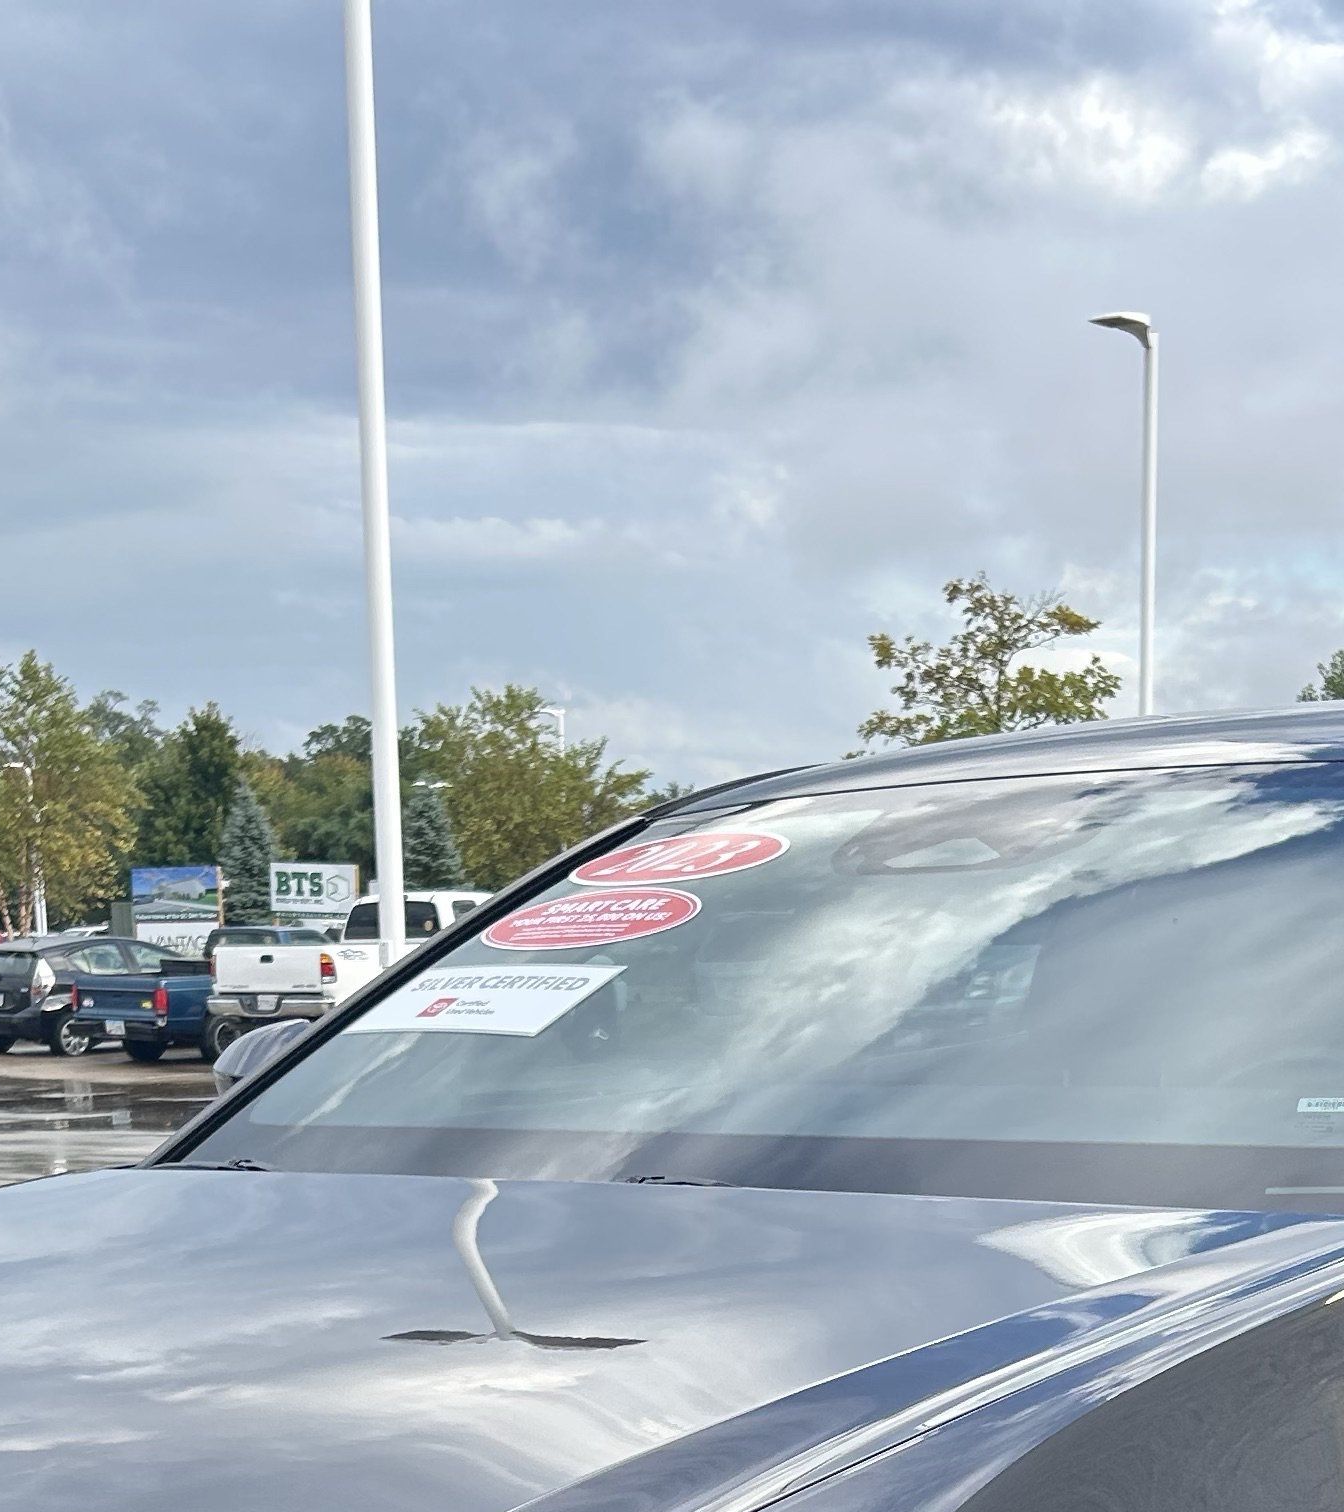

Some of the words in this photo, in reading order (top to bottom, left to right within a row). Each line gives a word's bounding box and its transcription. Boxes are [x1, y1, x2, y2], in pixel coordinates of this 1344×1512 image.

[588, 840, 761, 877] 2023
[275, 871, 324, 897] BTS
[541, 899, 617, 916] SMART
[611, 897, 671, 911] CARE
[411, 976, 481, 992] SILVER
[479, 975, 590, 991] CERTIFIED
